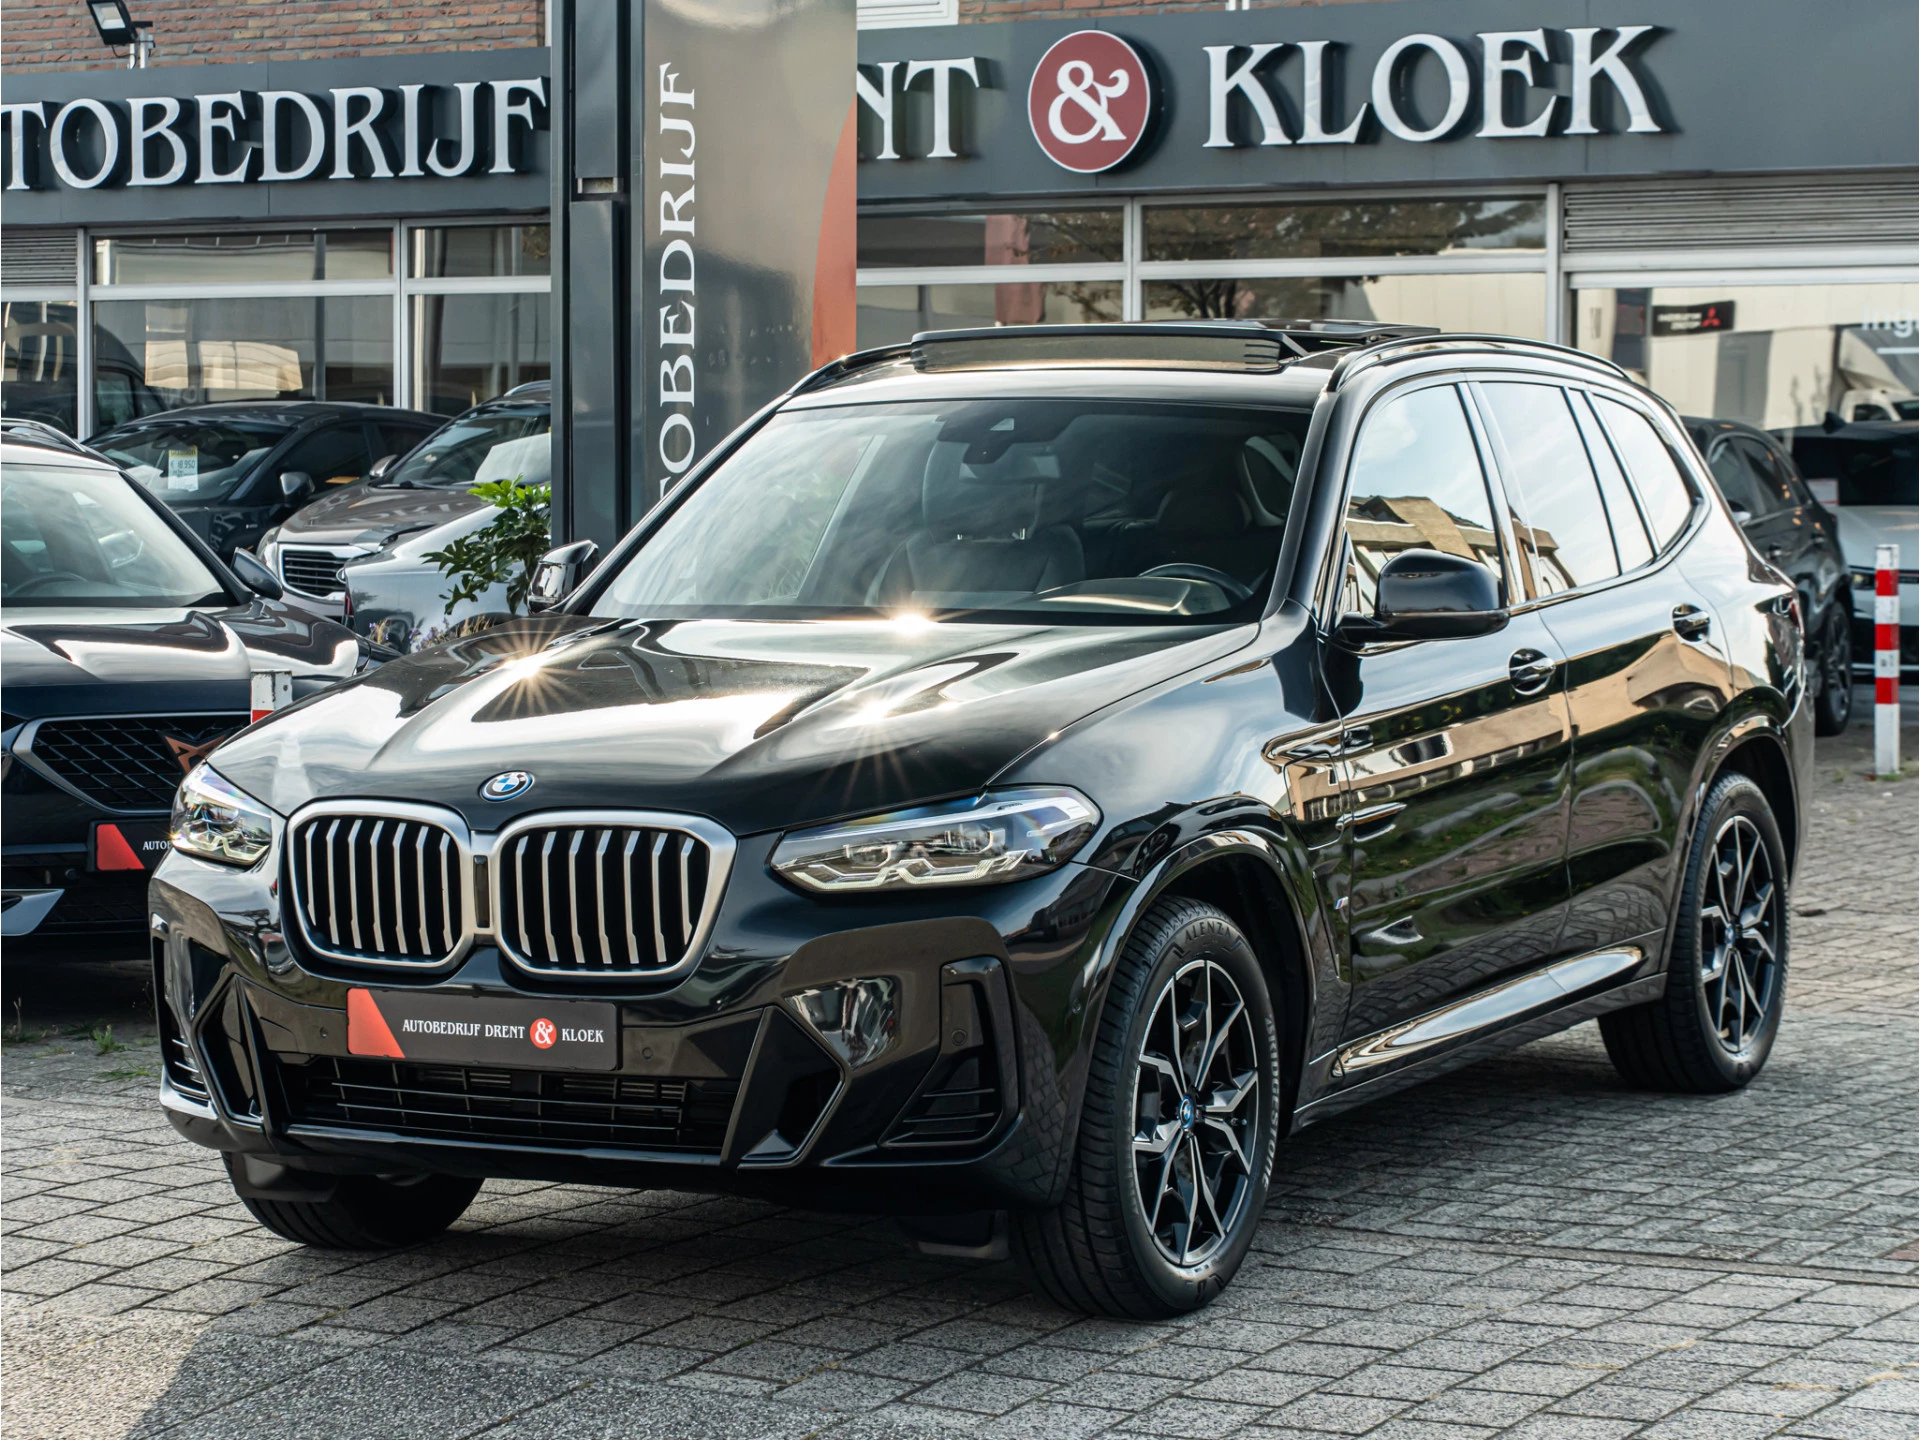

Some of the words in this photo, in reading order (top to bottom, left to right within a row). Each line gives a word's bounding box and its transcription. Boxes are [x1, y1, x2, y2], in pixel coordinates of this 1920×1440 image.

[1048, 59, 1129, 145] &
[1202, 25, 1663, 149] KLOEK
[1, 75, 547, 191] TOBEDRIJF
[1861, 302, 1919, 338] Ing
[1184, 920, 1232, 943] ALENZA
[402, 1018, 481, 1036] AUTOBEDRIJF
[484, 1024, 525, 1039] DRENT
[534, 1021, 553, 1044] &
[561, 1028, 604, 1043] KLOEK
